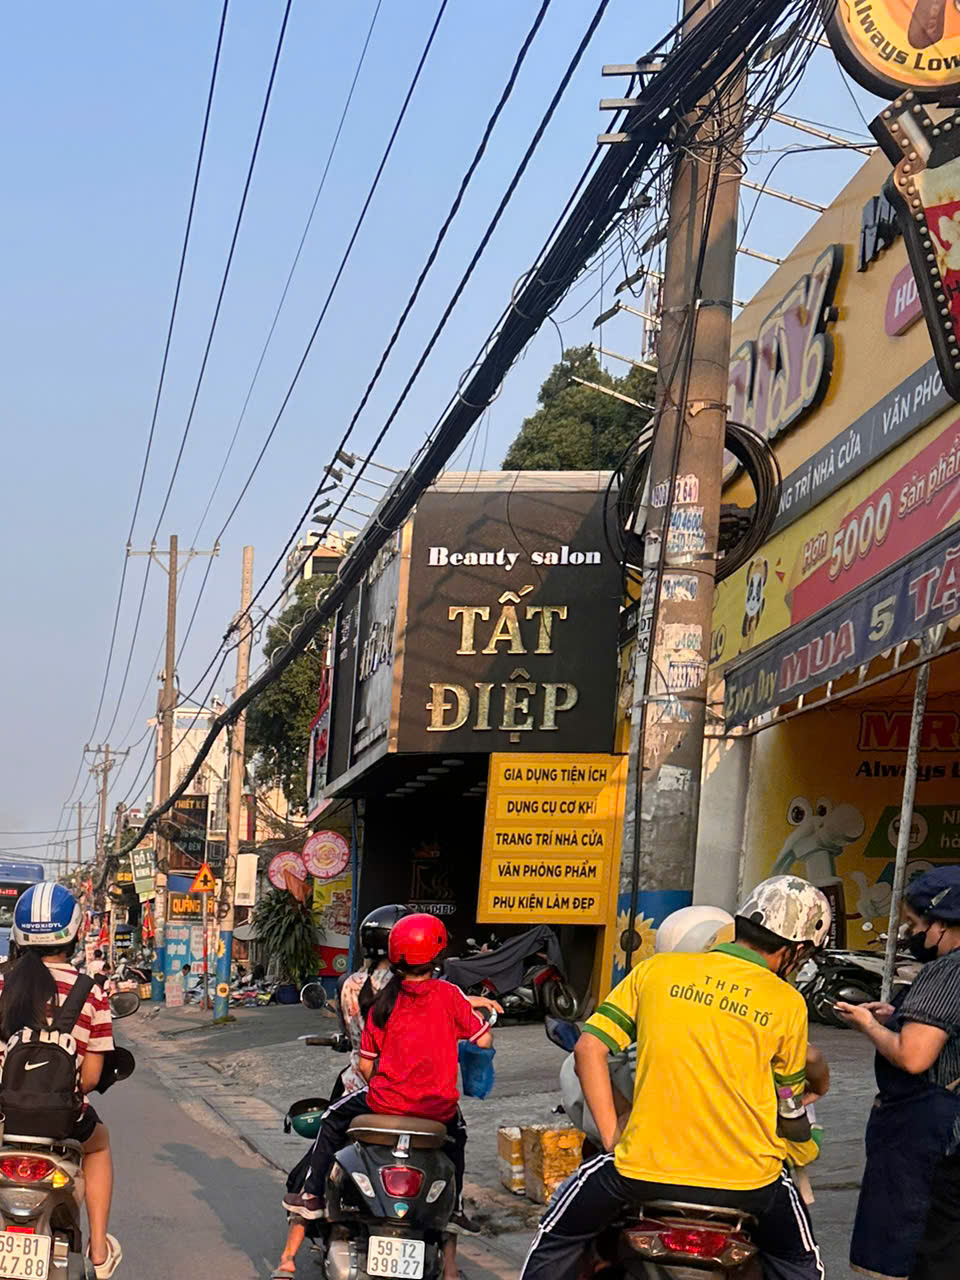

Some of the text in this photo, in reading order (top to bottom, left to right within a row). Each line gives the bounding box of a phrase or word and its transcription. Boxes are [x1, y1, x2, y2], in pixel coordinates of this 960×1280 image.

[812, 449, 835, 489] NHÀ
[882, 393, 911, 434] VĂN
[828, 490, 893, 579] 5000
[428, 546, 602, 571] Beauty salon
[448, 585, 568, 655] TẤT
[779, 619, 856, 693] MUA
[868, 595, 897, 641] 5
[426, 668, 579, 743] ĐIỆP
[503, 766, 607, 785] GIA DỤNG TIỆN ÍCH
[507, 801, 539, 816] DỤNG
[541, 801, 557, 816] CỤ
[559, 800, 577, 813] CƠ
[496, 829, 603, 846] TRANG TRÍ NHÀ CỬA
[498, 860, 597, 877] VĂN PHÒNG PHẨM
[493, 893, 594, 912] PHỤ KIỆN LÀM ĐẸP
[670, 983, 773, 1027] GIỒNG ÔNG TỐ
[377, 1240, 417, 1259] 59-T2
[371, 1257, 420, 1276] 398.27
